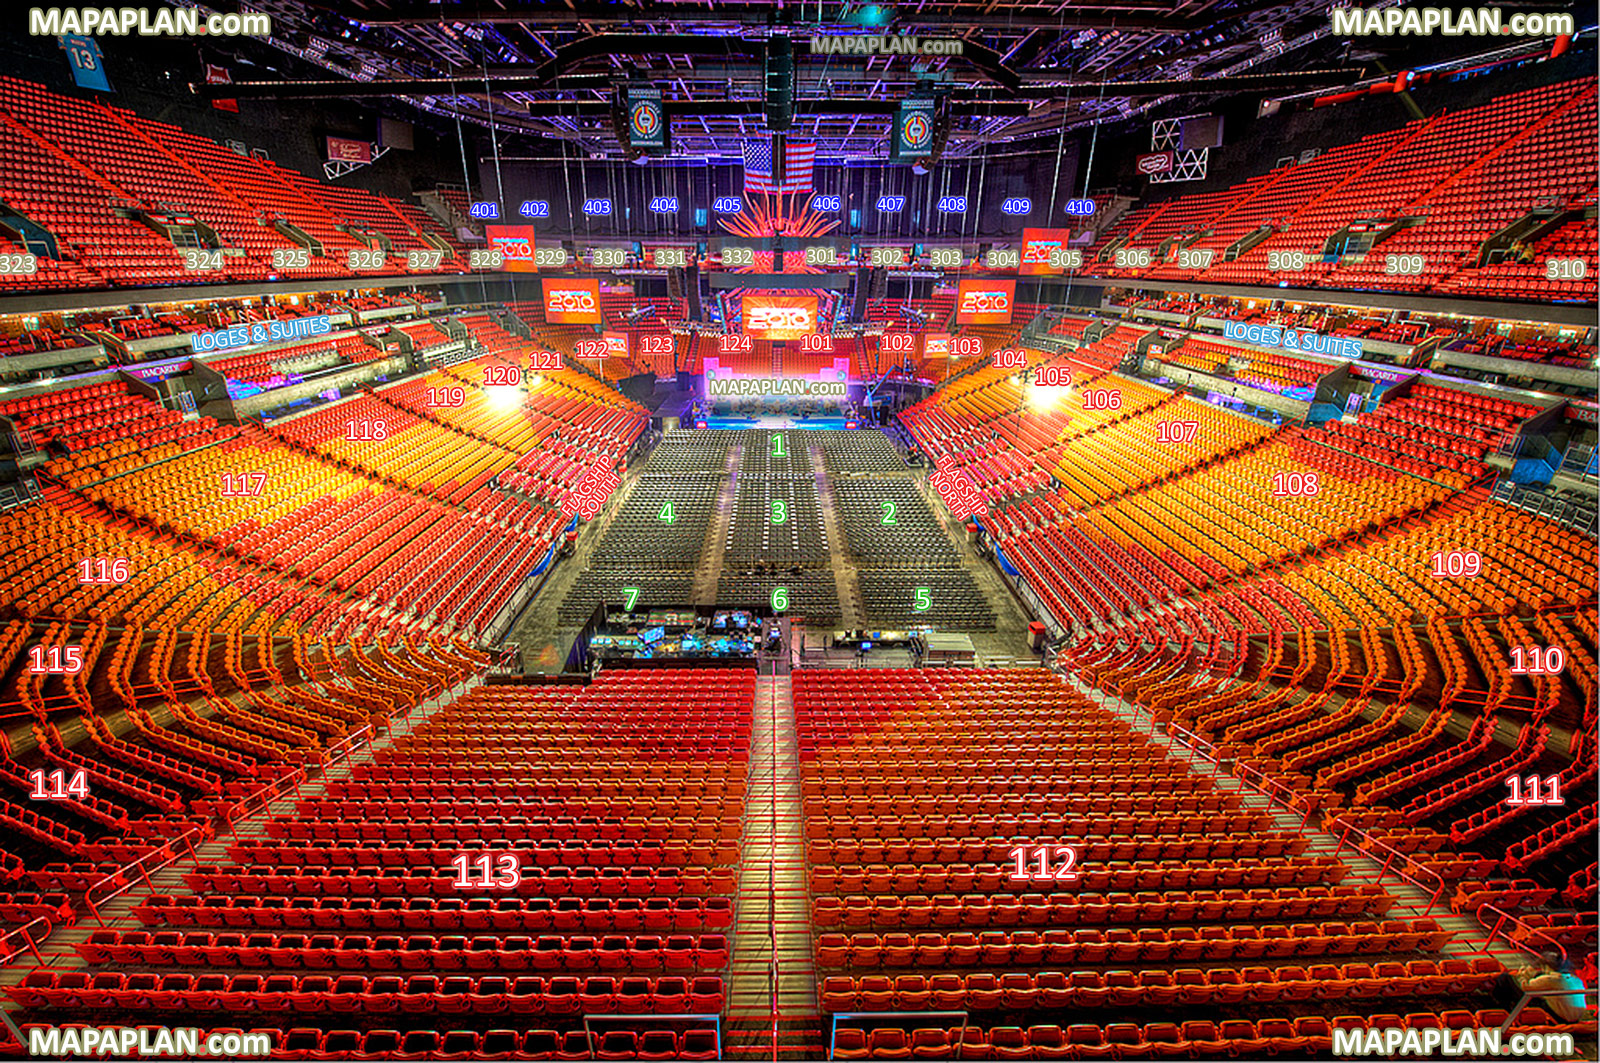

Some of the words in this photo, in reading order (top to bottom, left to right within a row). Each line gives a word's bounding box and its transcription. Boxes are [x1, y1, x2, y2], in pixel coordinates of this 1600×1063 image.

[70, 47, 97, 71] 13
[549, 295, 595, 308] 2010
[962, 296, 1008, 309] 2010
[747, 311, 810, 326] 2010
[1577, 410, 1597, 424] BA
